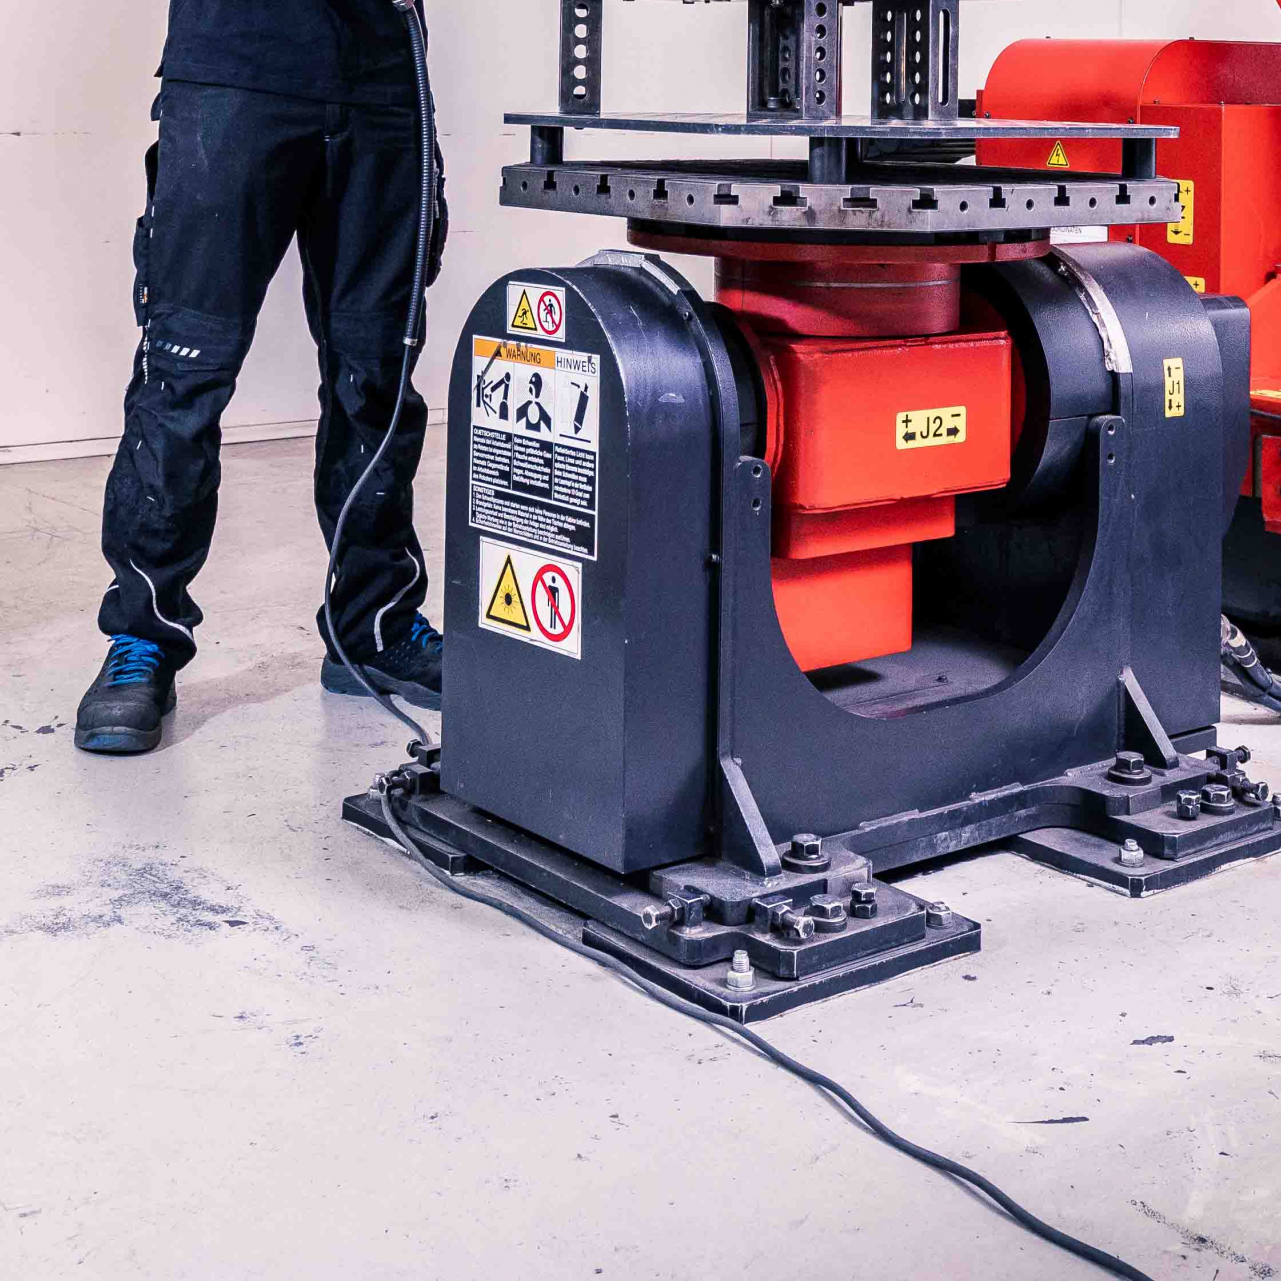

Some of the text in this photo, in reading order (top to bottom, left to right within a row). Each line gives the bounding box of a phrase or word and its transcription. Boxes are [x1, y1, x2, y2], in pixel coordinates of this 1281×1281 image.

[505, 346, 541, 364] WARNUNG
[556, 356, 596, 374] HINWEIS
[1168, 380, 1180, 396] J1
[474, 428, 506, 441] QUETSCHSTELLE
[920, 416, 942, 439] J2
